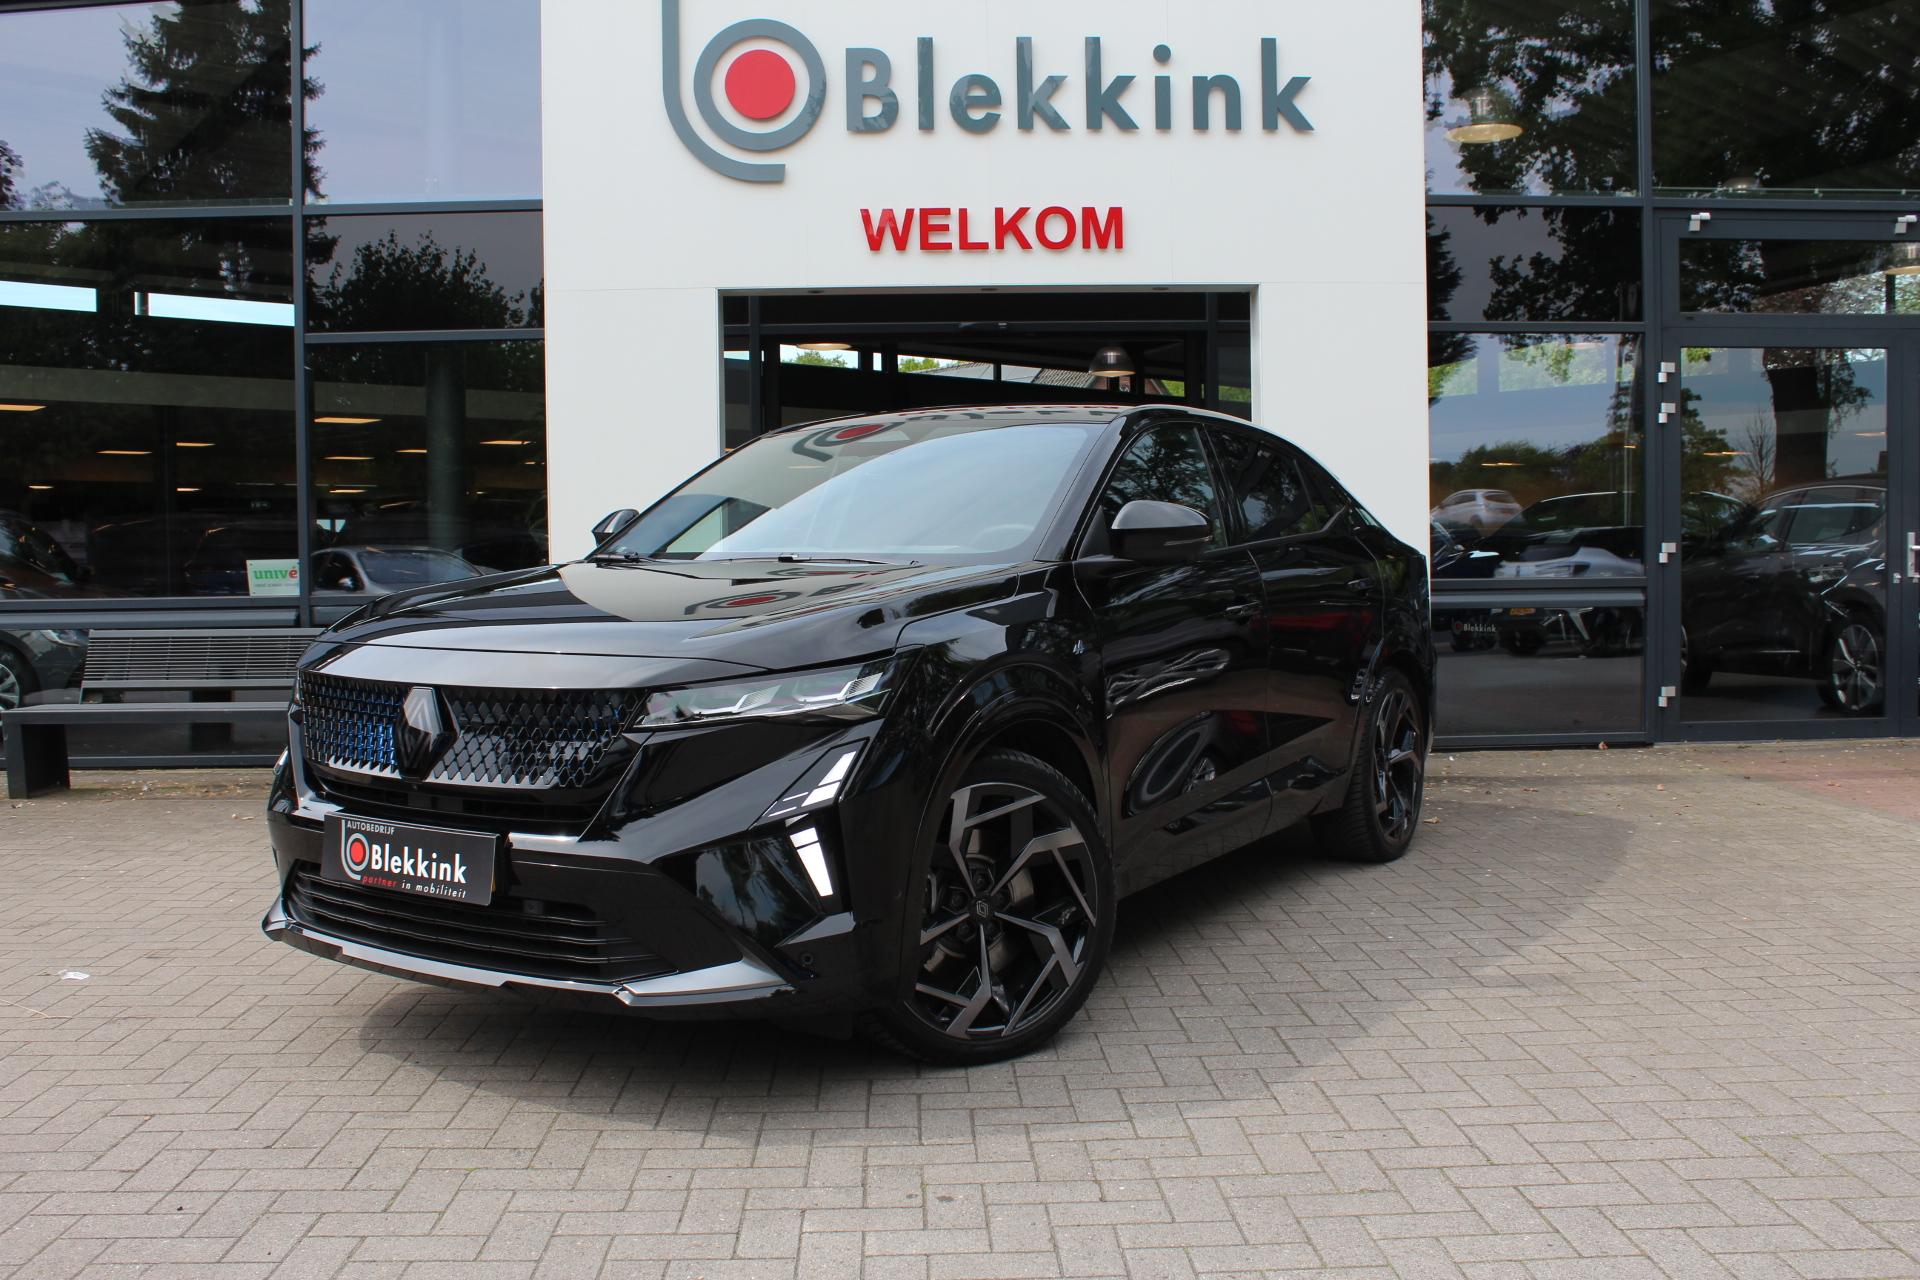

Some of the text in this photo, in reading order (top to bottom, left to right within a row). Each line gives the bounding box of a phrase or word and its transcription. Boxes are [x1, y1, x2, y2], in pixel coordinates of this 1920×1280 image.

[845, 37, 1314, 133] Blekkink
[860, 206, 1125, 253] WELKOM
[347, 820, 395, 835] AUTOBEDRIJF
[371, 843, 468, 884] Blekkink
[362, 875, 466, 898] partner in mobiliteit
